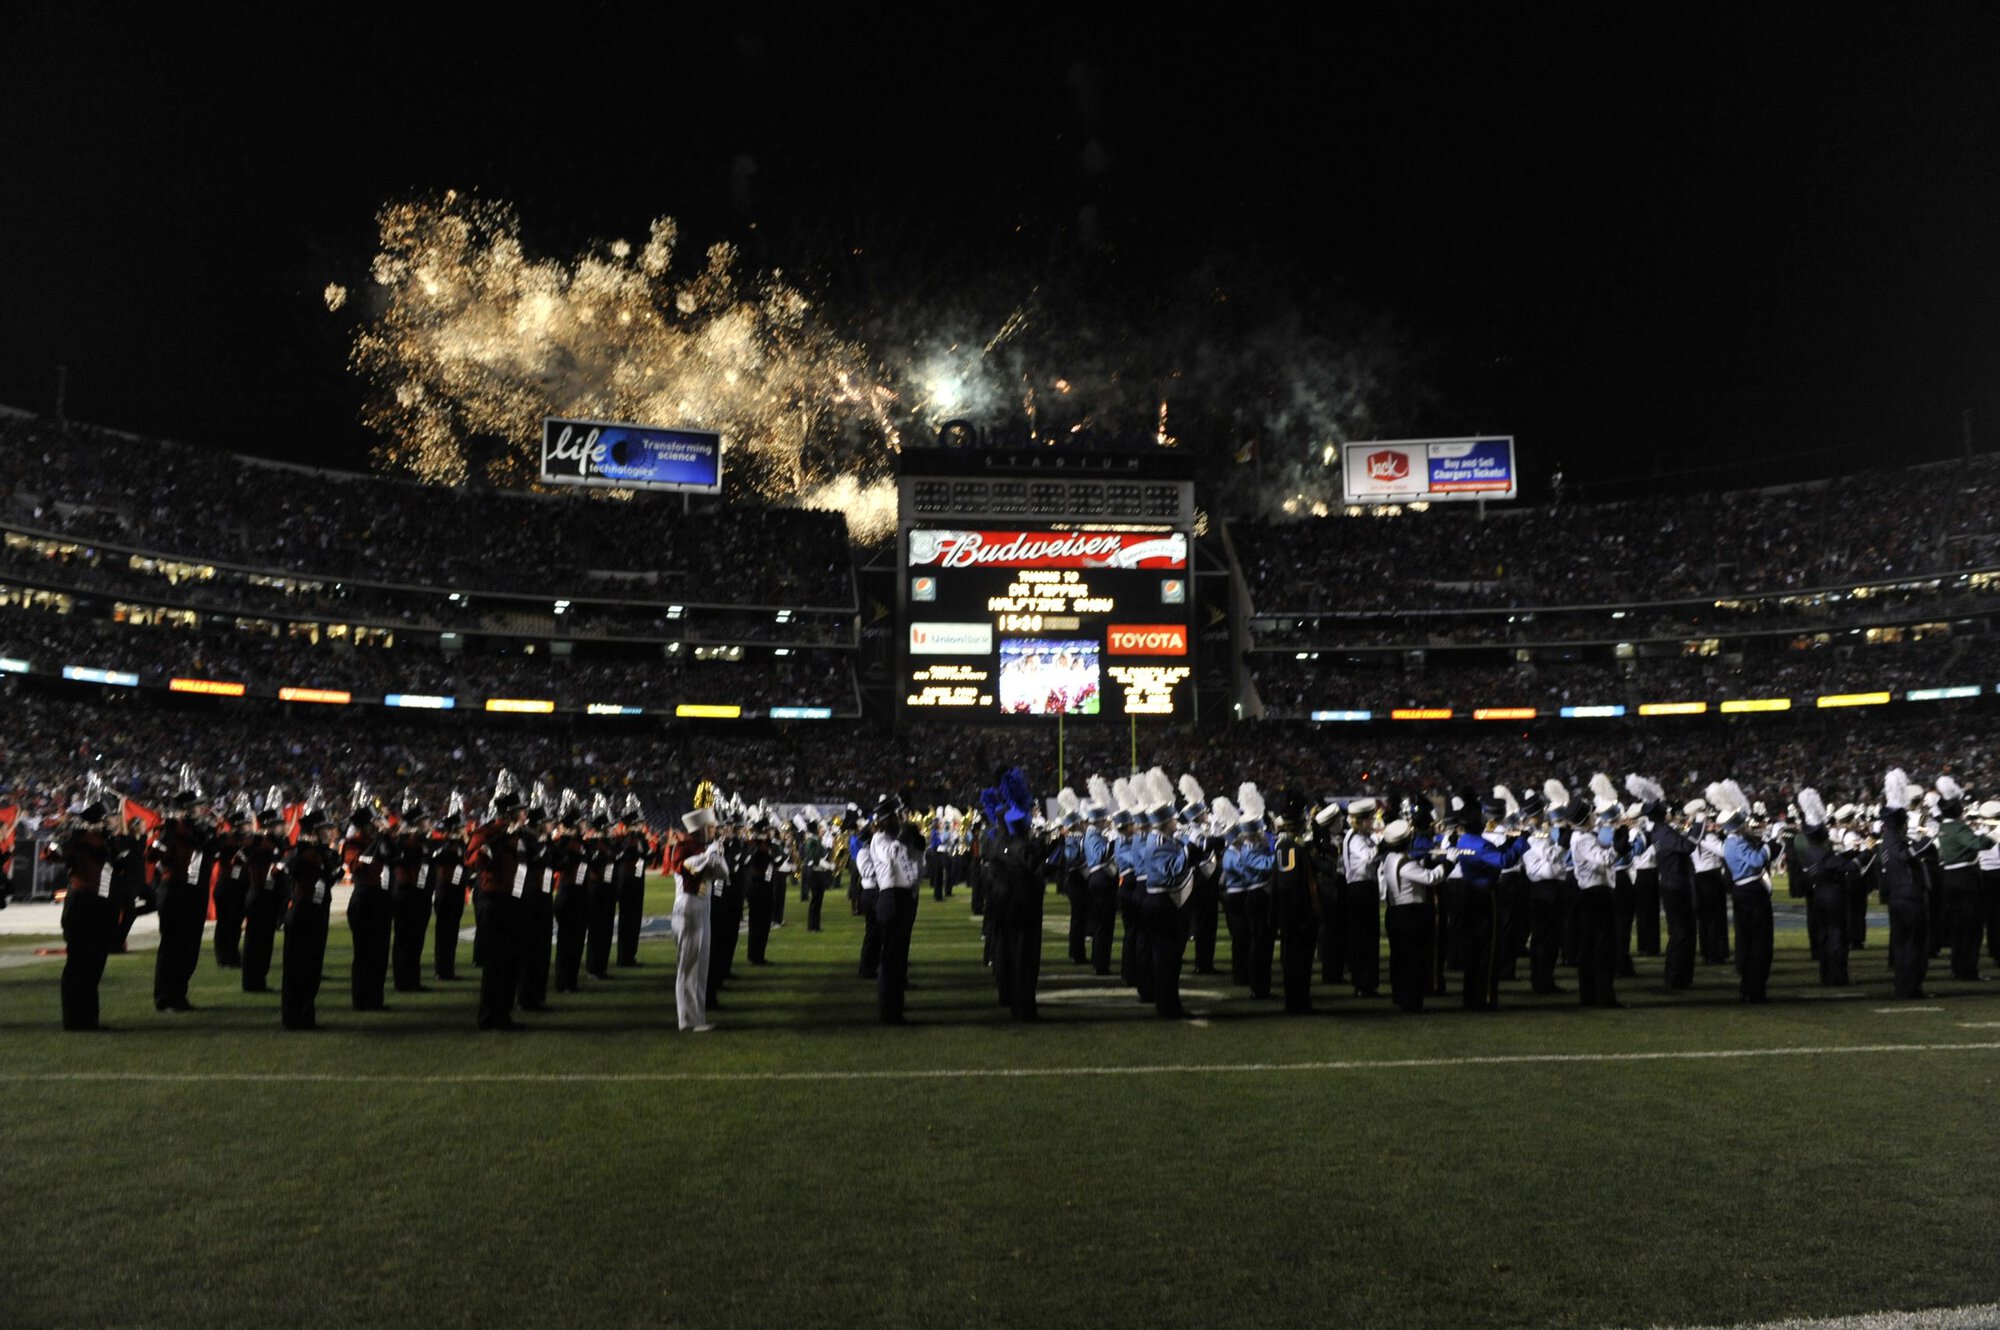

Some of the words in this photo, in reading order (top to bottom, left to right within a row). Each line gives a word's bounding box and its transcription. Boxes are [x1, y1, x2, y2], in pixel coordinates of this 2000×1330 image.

[547, 425, 607, 475] life
[642, 439, 712, 455] Transforming
[658, 451, 696, 462] science
[589, 463, 655, 476] technologies
[935, 532, 1121, 568] Budweiser
[1111, 632, 1183, 649] TOYOTA
